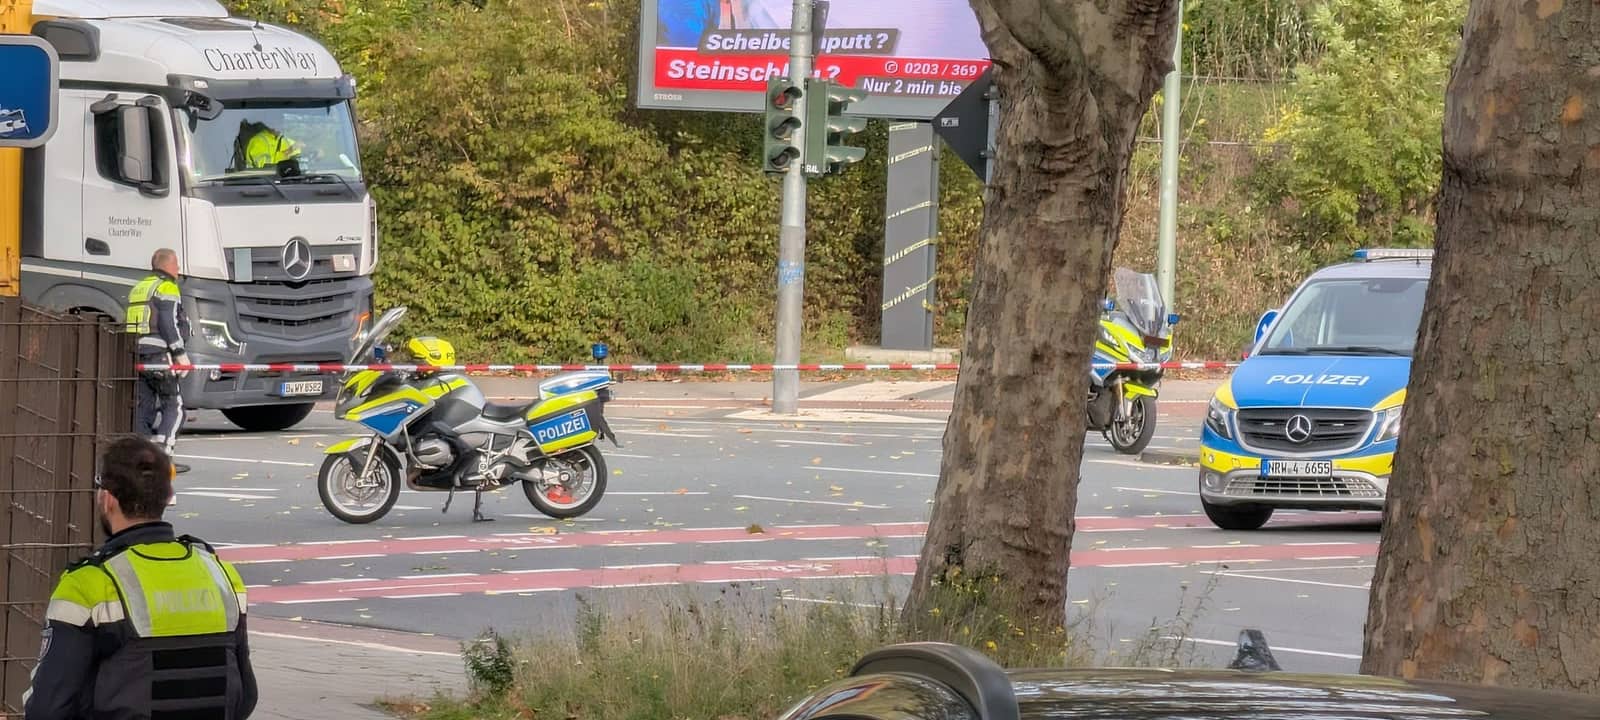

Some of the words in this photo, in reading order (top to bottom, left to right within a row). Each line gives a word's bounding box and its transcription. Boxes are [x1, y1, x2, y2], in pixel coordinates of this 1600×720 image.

[204, 47, 318, 76] CharterWay
[904, 63, 939, 75] 0203
[951, 64, 977, 77] 369
[863, 78, 891, 93] Nur
[894, 80, 904, 94] 2
[906, 81, 935, 95] min
[938, 81, 962, 95] bis
[108, 227, 142, 238] CharterWay
[1266, 374, 1370, 386] POLIZEI
[538, 416, 586, 443] POLIZEI
[1268, 462, 1288, 475] NRW
